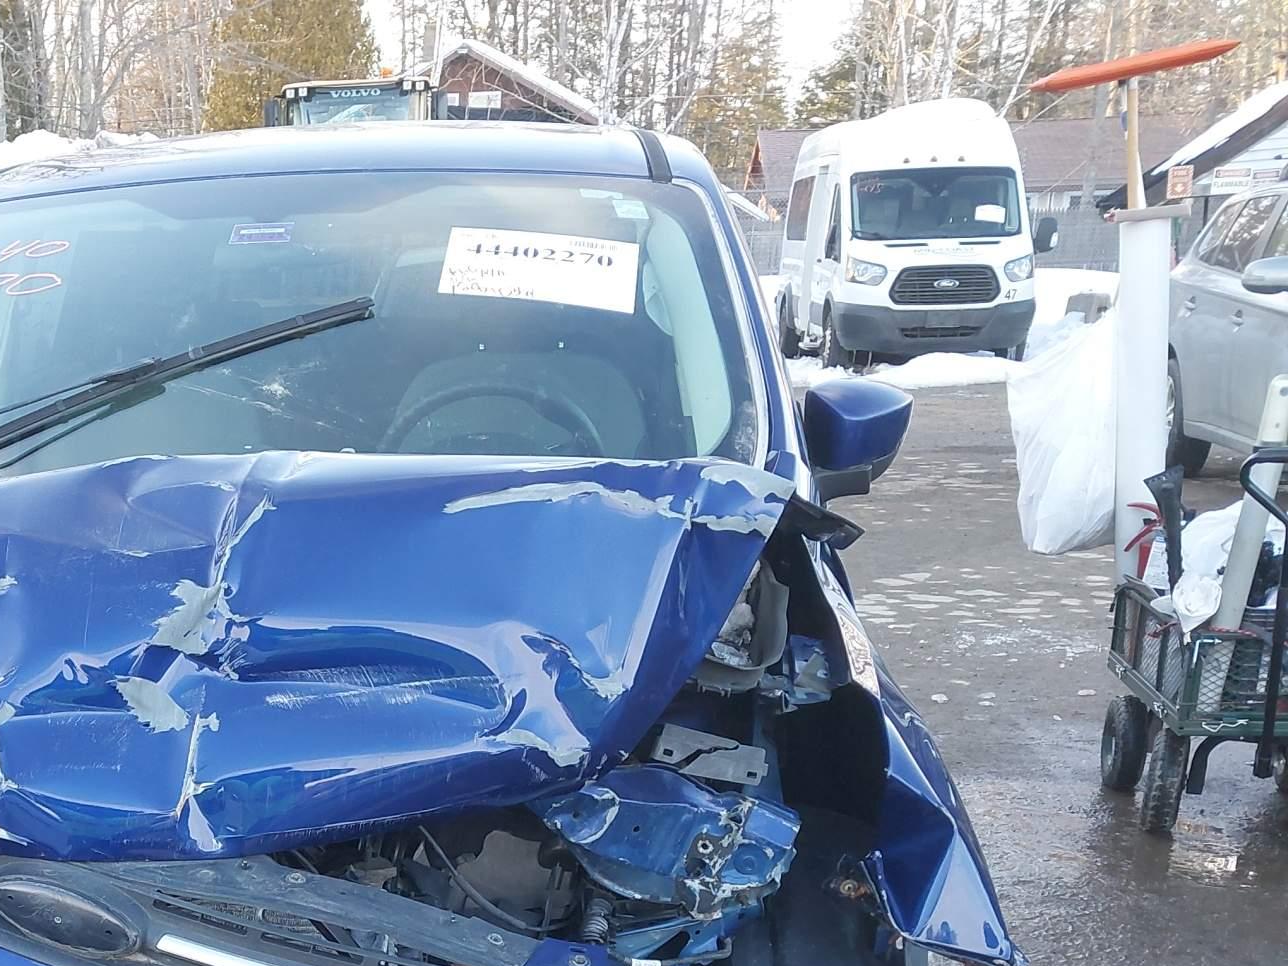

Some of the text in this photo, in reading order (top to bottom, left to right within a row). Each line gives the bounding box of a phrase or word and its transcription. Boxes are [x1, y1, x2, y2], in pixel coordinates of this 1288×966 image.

[330, 87, 381, 98] VOLVO
[467, 243, 613, 267] 44402270
[1004, 289, 1017, 300] 47
